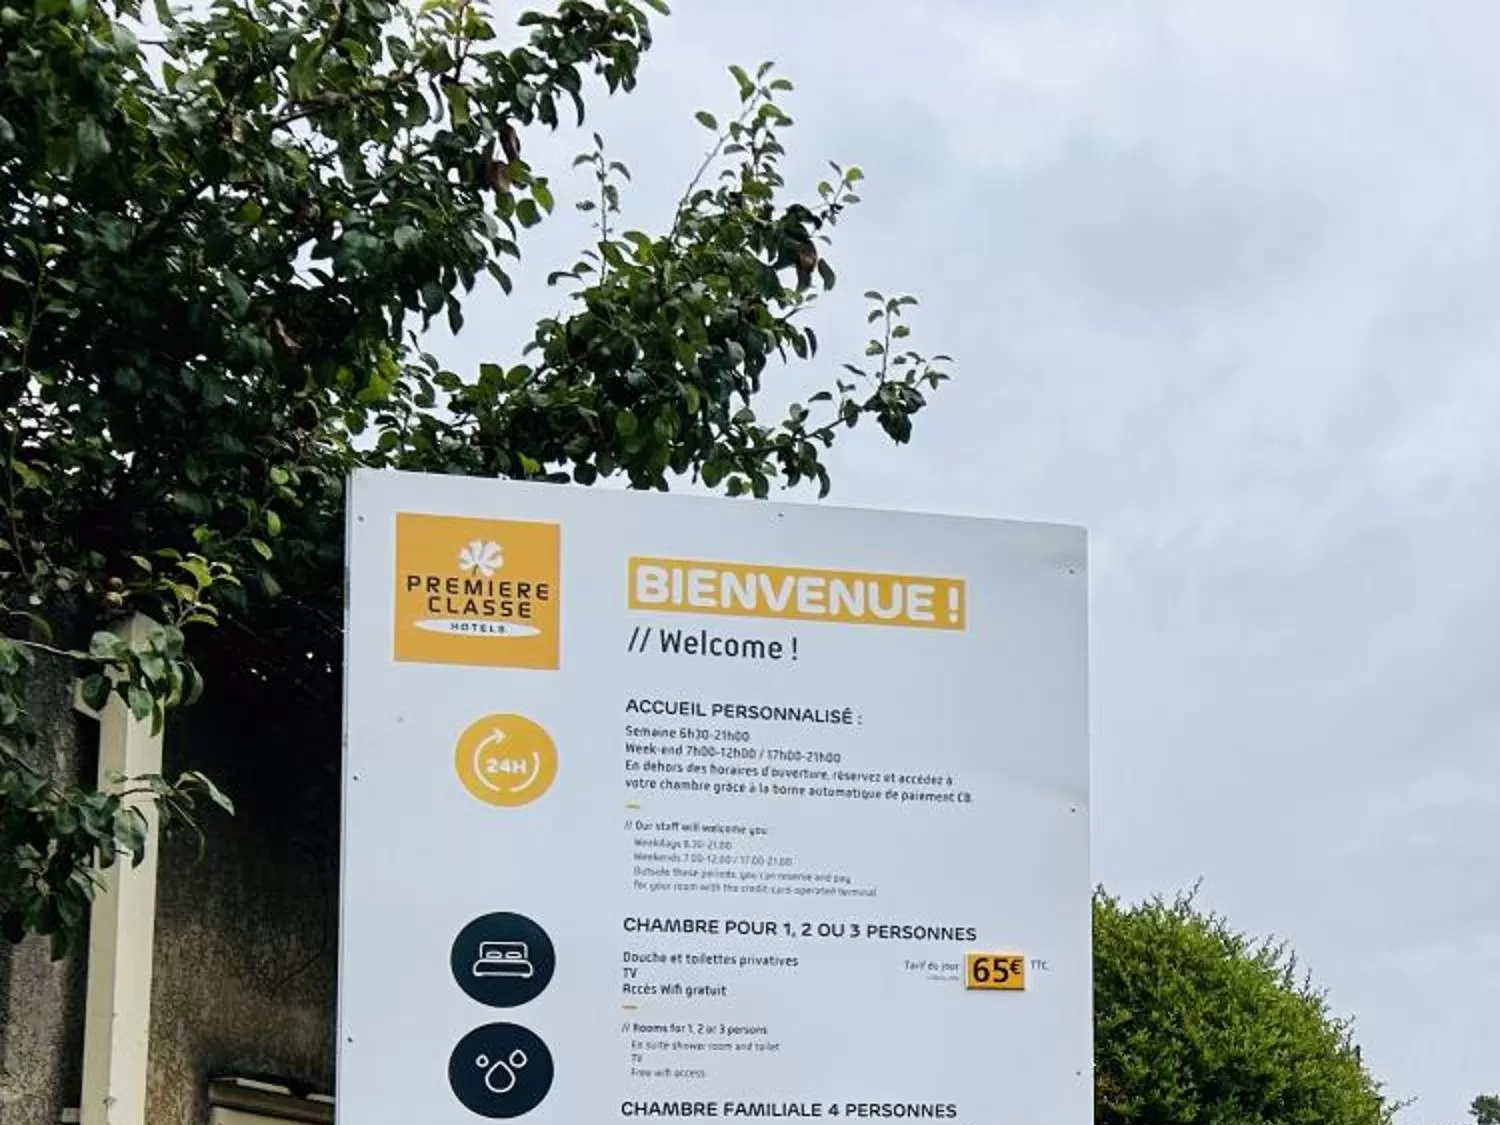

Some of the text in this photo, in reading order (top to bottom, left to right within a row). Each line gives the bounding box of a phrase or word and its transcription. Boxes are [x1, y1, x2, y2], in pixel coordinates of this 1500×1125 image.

[406, 575, 551, 600] PREMIERE
[637, 565, 935, 622] BIENVENUE
[427, 596, 533, 619] CLASSE
[450, 622, 506, 634] HOTELS
[660, 629, 784, 661] Welcome
[625, 699, 853, 725] ACCUEIL PERSONNALISÉ
[486, 759, 528, 775] 24H
[622, 916, 977, 942] CHAMBRE POUR 1, 2 OU 3 PERSONNES
[622, 950, 799, 969] Douche et toilettes privatives
[622, 967, 638, 978] TV
[620, 1100, 957, 1118] CHAMBRE FAMILIALE 4 PERSONNES
